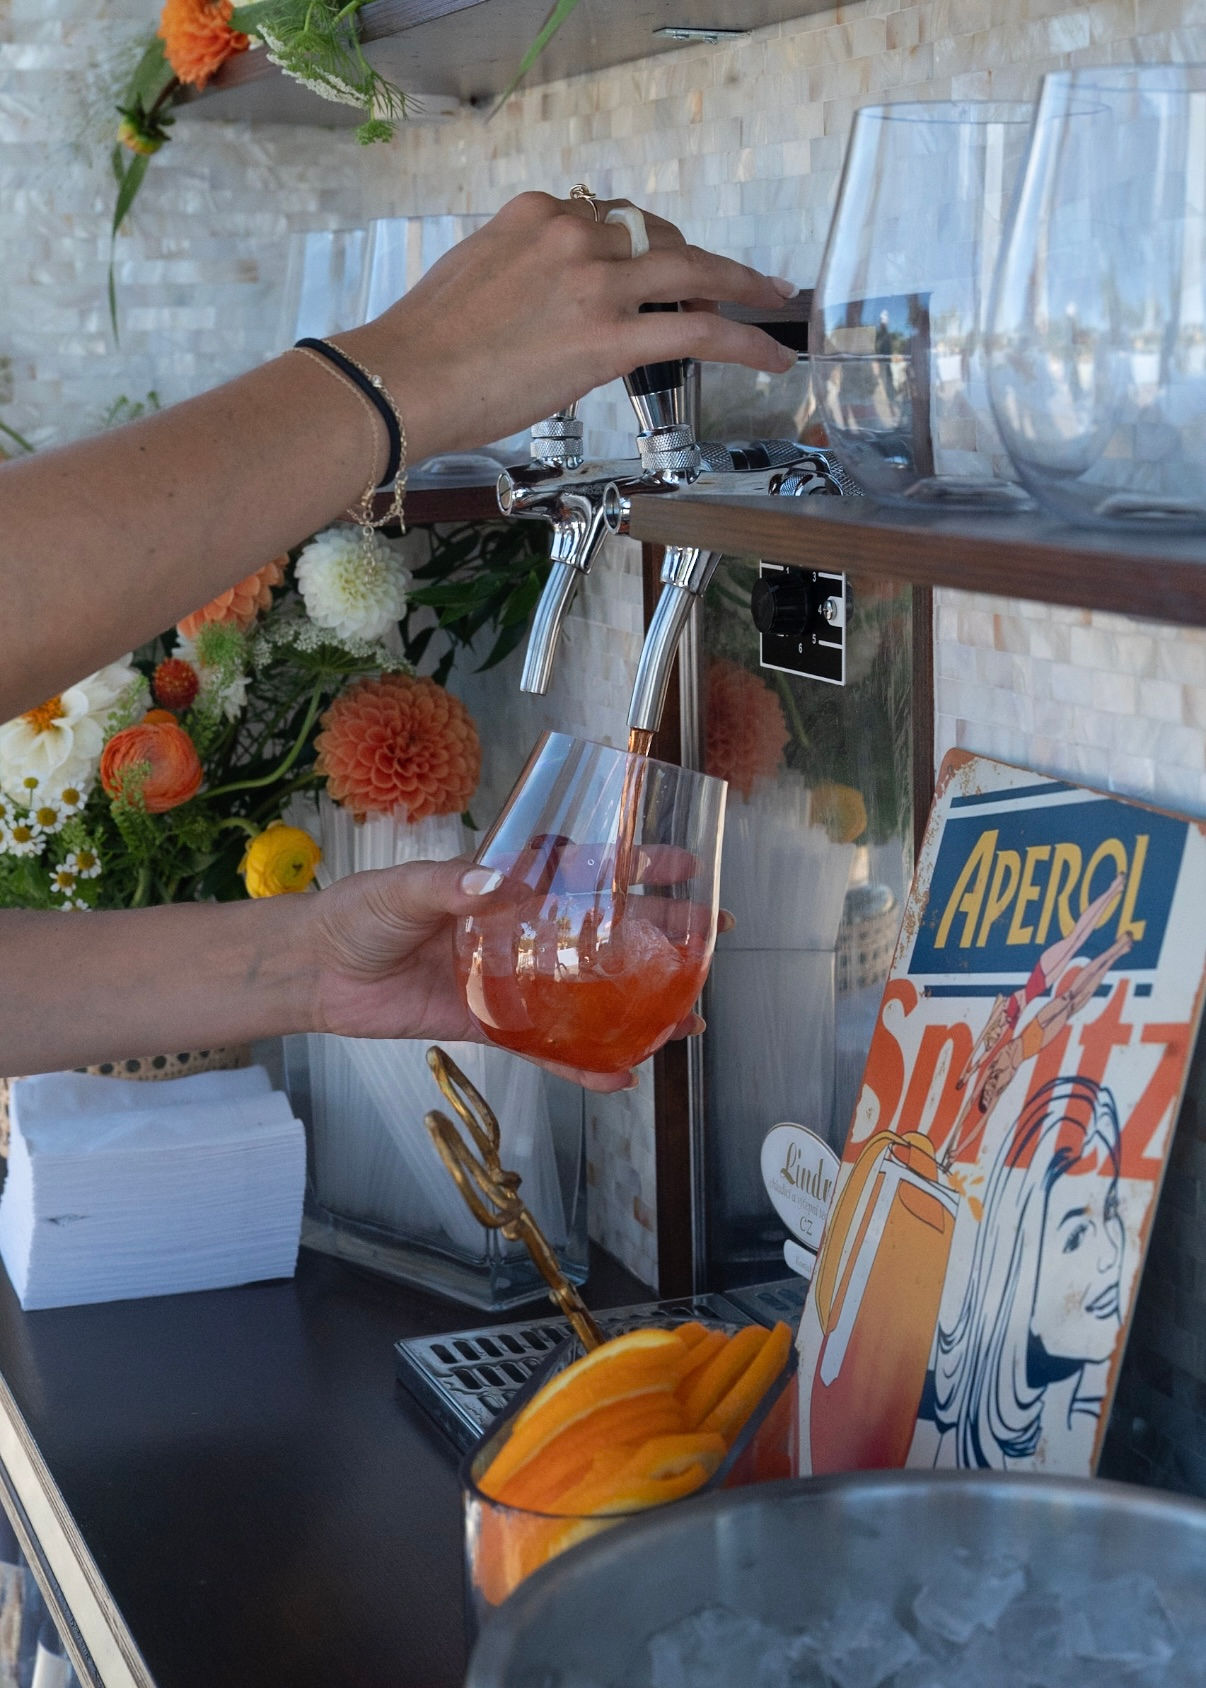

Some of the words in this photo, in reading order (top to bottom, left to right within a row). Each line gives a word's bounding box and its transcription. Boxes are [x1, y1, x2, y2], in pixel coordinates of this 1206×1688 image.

[812, 571, 817, 582] 3
[812, 634, 817, 645] 5
[798, 642, 803, 654] 6
[934, 829, 1150, 949] APEROL
[780, 1141, 833, 1203] Lindr
[800, 1216, 813, 1236] CZ
